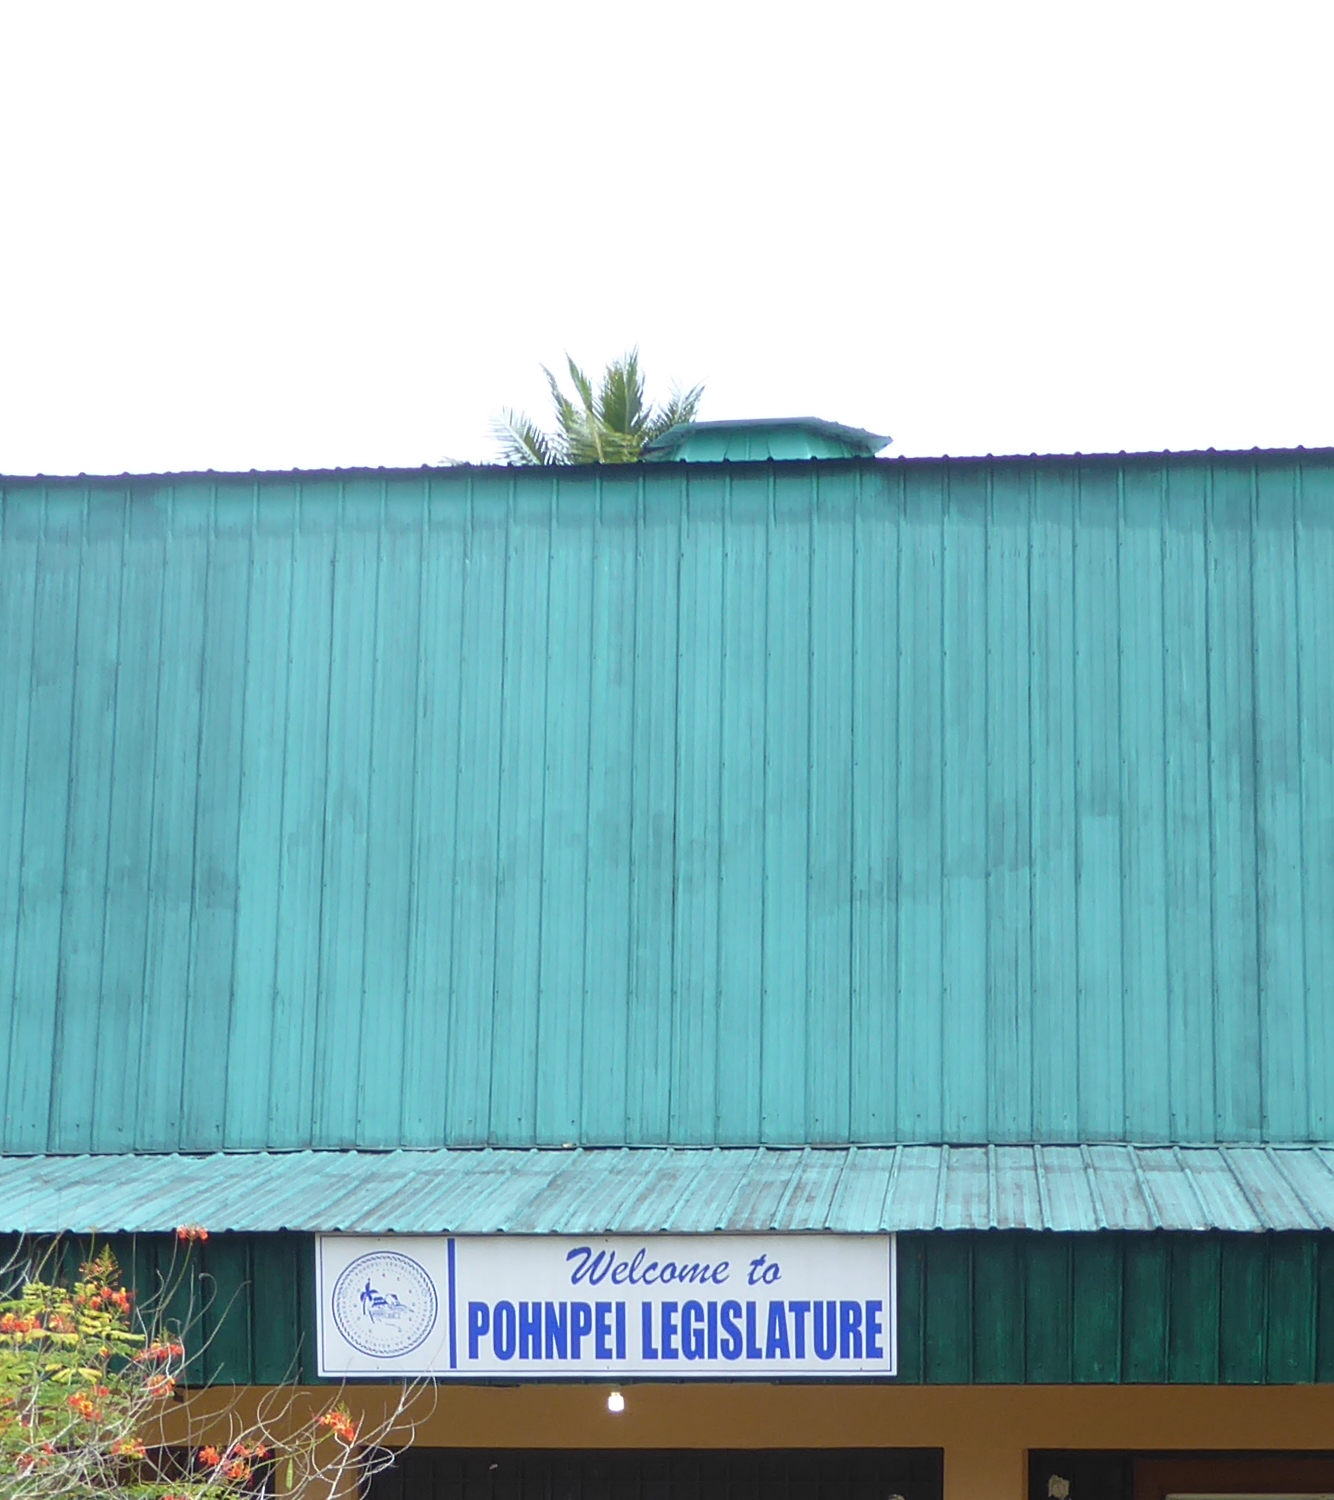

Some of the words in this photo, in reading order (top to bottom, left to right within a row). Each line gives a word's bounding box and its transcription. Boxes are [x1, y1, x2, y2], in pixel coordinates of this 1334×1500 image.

[566, 1246, 730, 1286] Welcome
[747, 1254, 782, 1286] to
[468, 1299, 627, 1361] POHNPEI
[641, 1299, 884, 1361] LEGISLATURE
